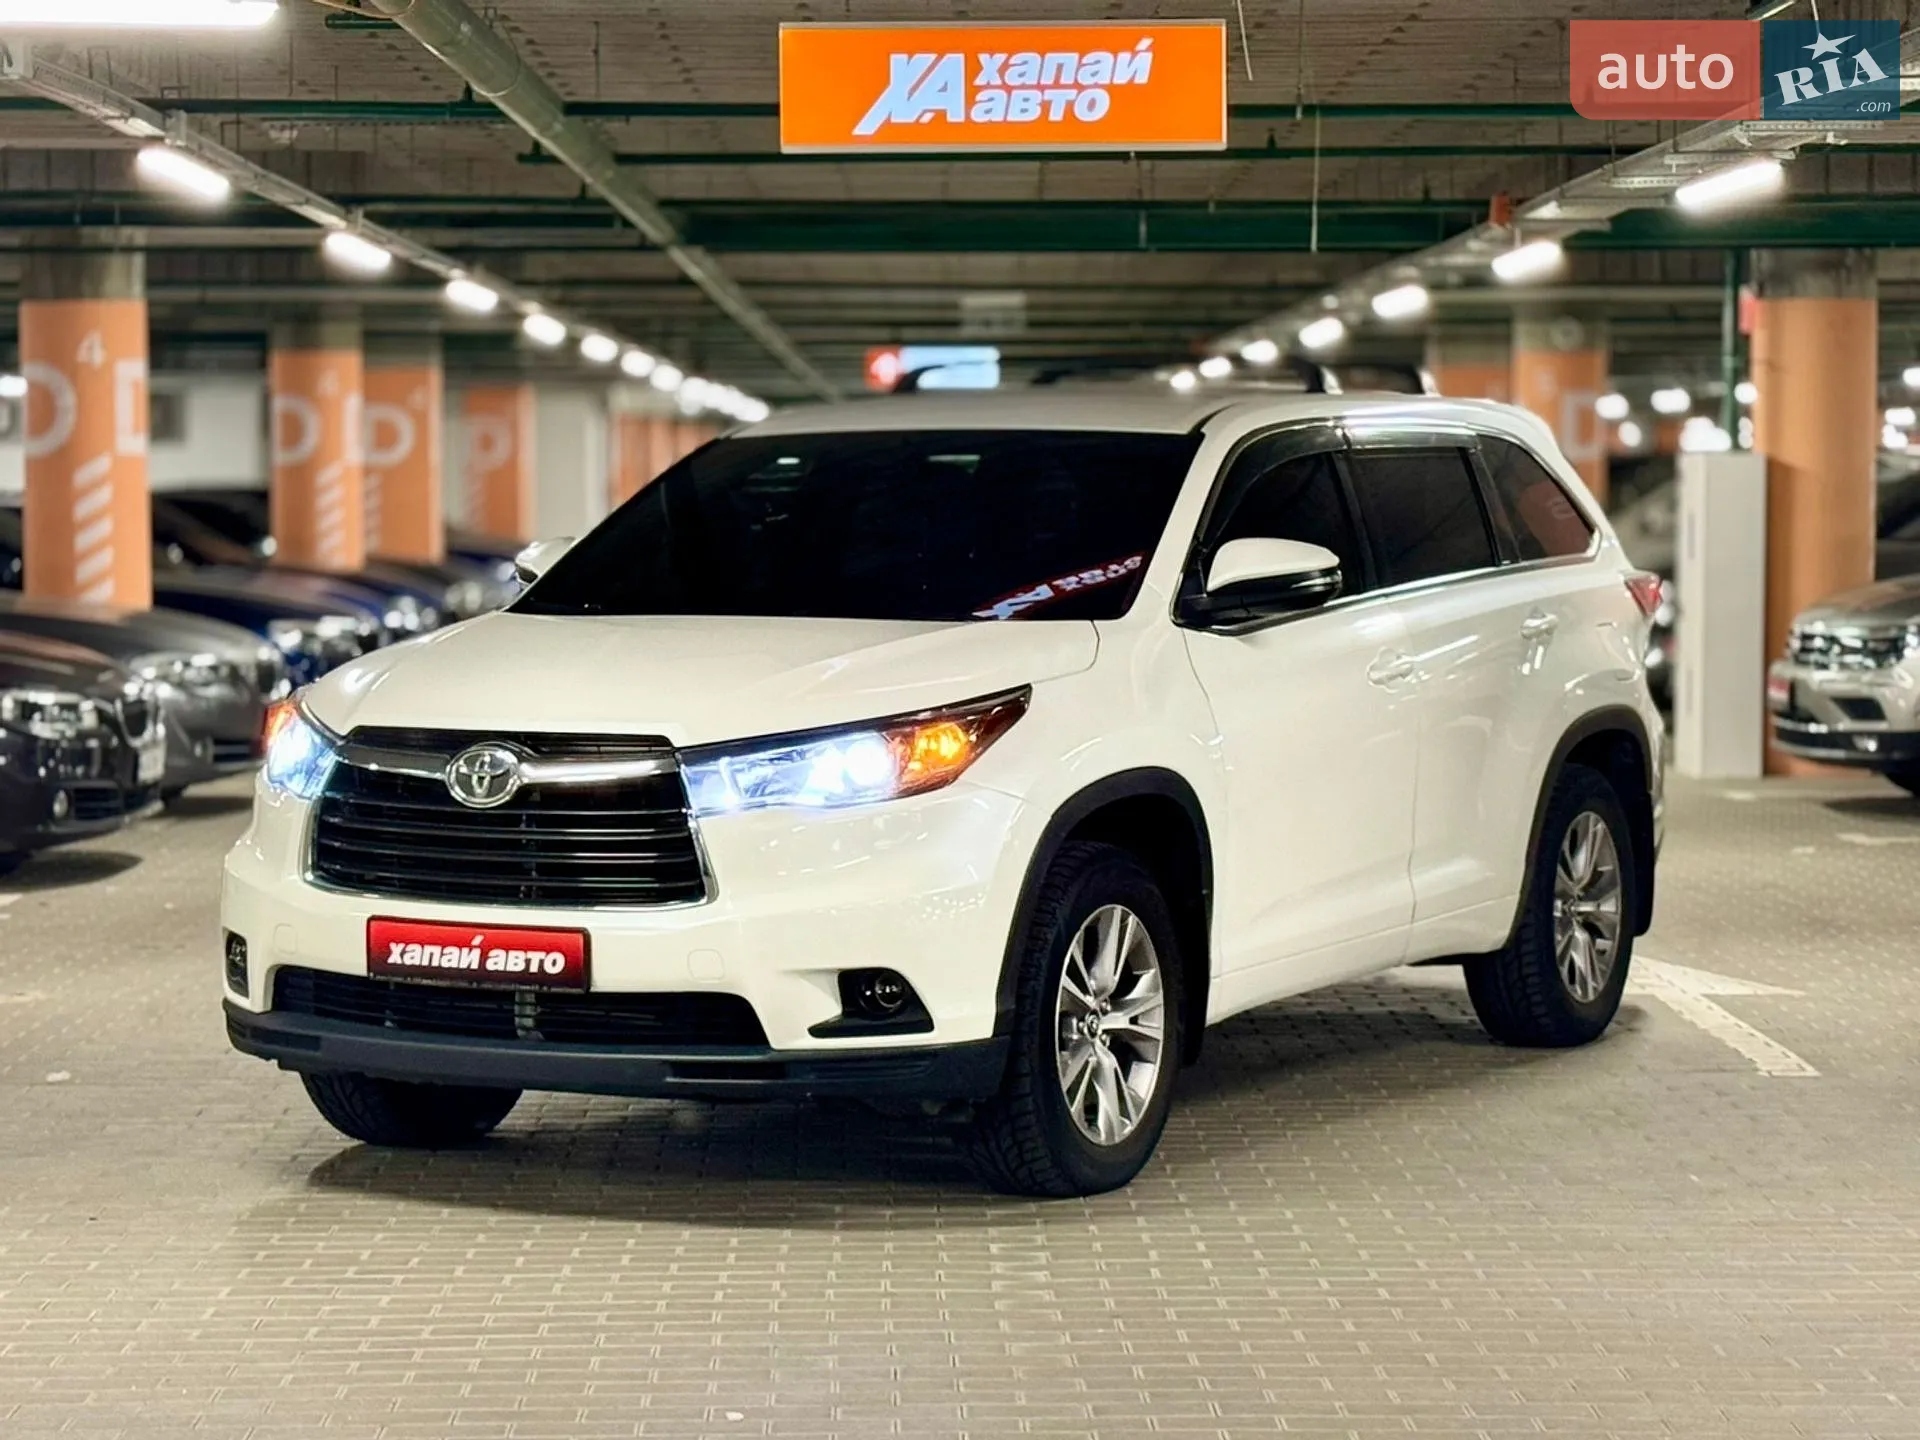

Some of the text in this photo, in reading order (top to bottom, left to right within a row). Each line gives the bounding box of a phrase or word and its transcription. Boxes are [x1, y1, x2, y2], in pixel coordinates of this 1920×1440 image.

[973, 38, 1154, 86] хапай
[970, 88, 1110, 122] авто
[387, 934, 566, 975] хапай авто
